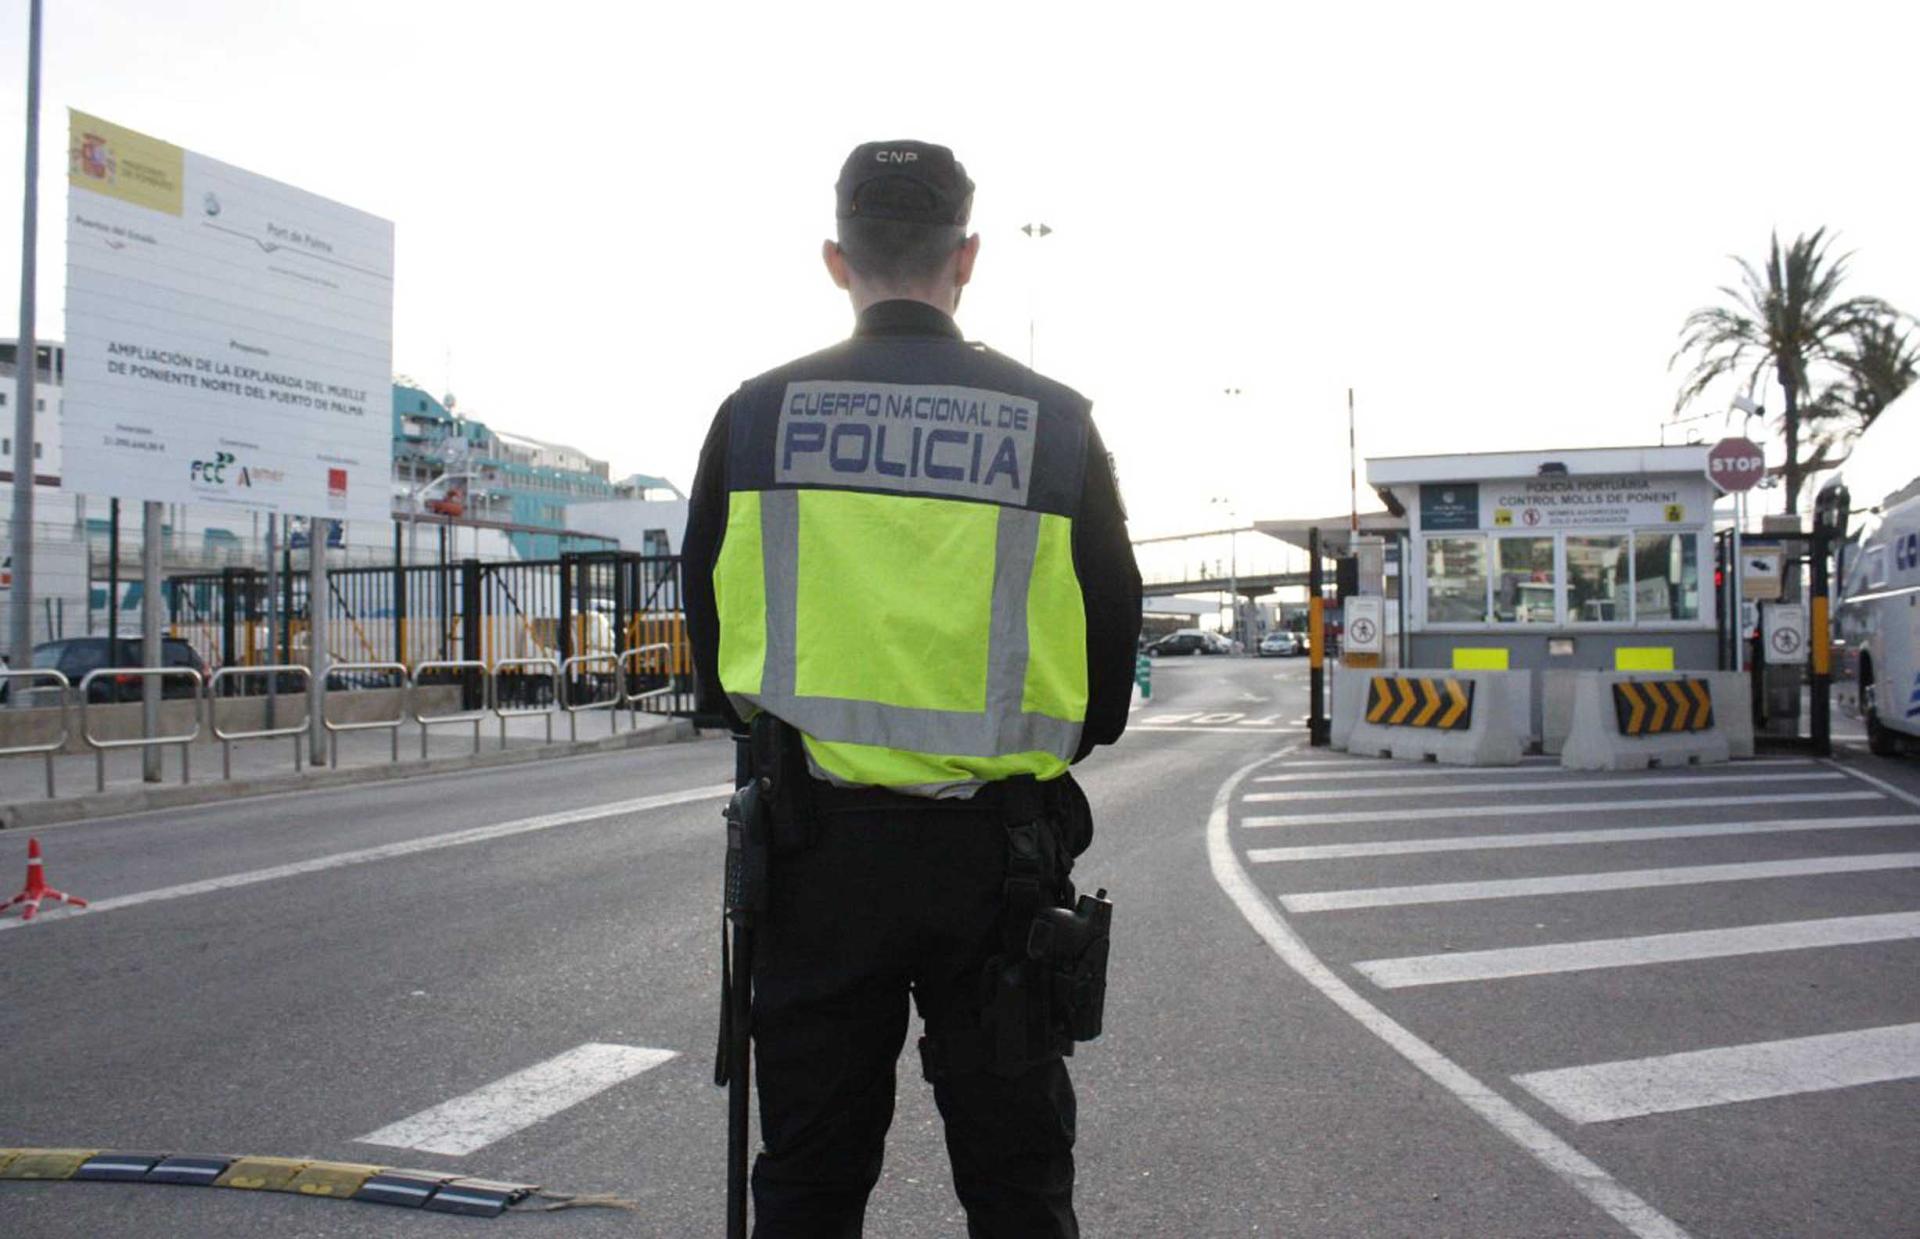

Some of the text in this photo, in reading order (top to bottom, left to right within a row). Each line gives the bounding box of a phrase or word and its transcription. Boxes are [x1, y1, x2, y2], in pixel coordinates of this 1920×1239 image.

[876, 151, 918, 163] CNP
[107, 360, 126, 375] DE
[130, 363, 198, 388] PONIENTE
[200, 377, 242, 397] NORTE
[243, 385, 267, 400] DEL
[269, 389, 313, 407] PUERTO
[314, 398, 329, 411] DE
[195, 357, 212, 373] DE
[215, 361, 231, 376] LA
[305, 379, 325, 395] DEL
[789, 392, 1029, 431] CUERPO NACIONAL DE
[782, 421, 1020, 490] POLICIA
[1712, 456, 1762, 473] STOP
[191, 459, 227, 484] FCC
[1499, 492, 1678, 507] CONTROL MOLLS DE PONENT
